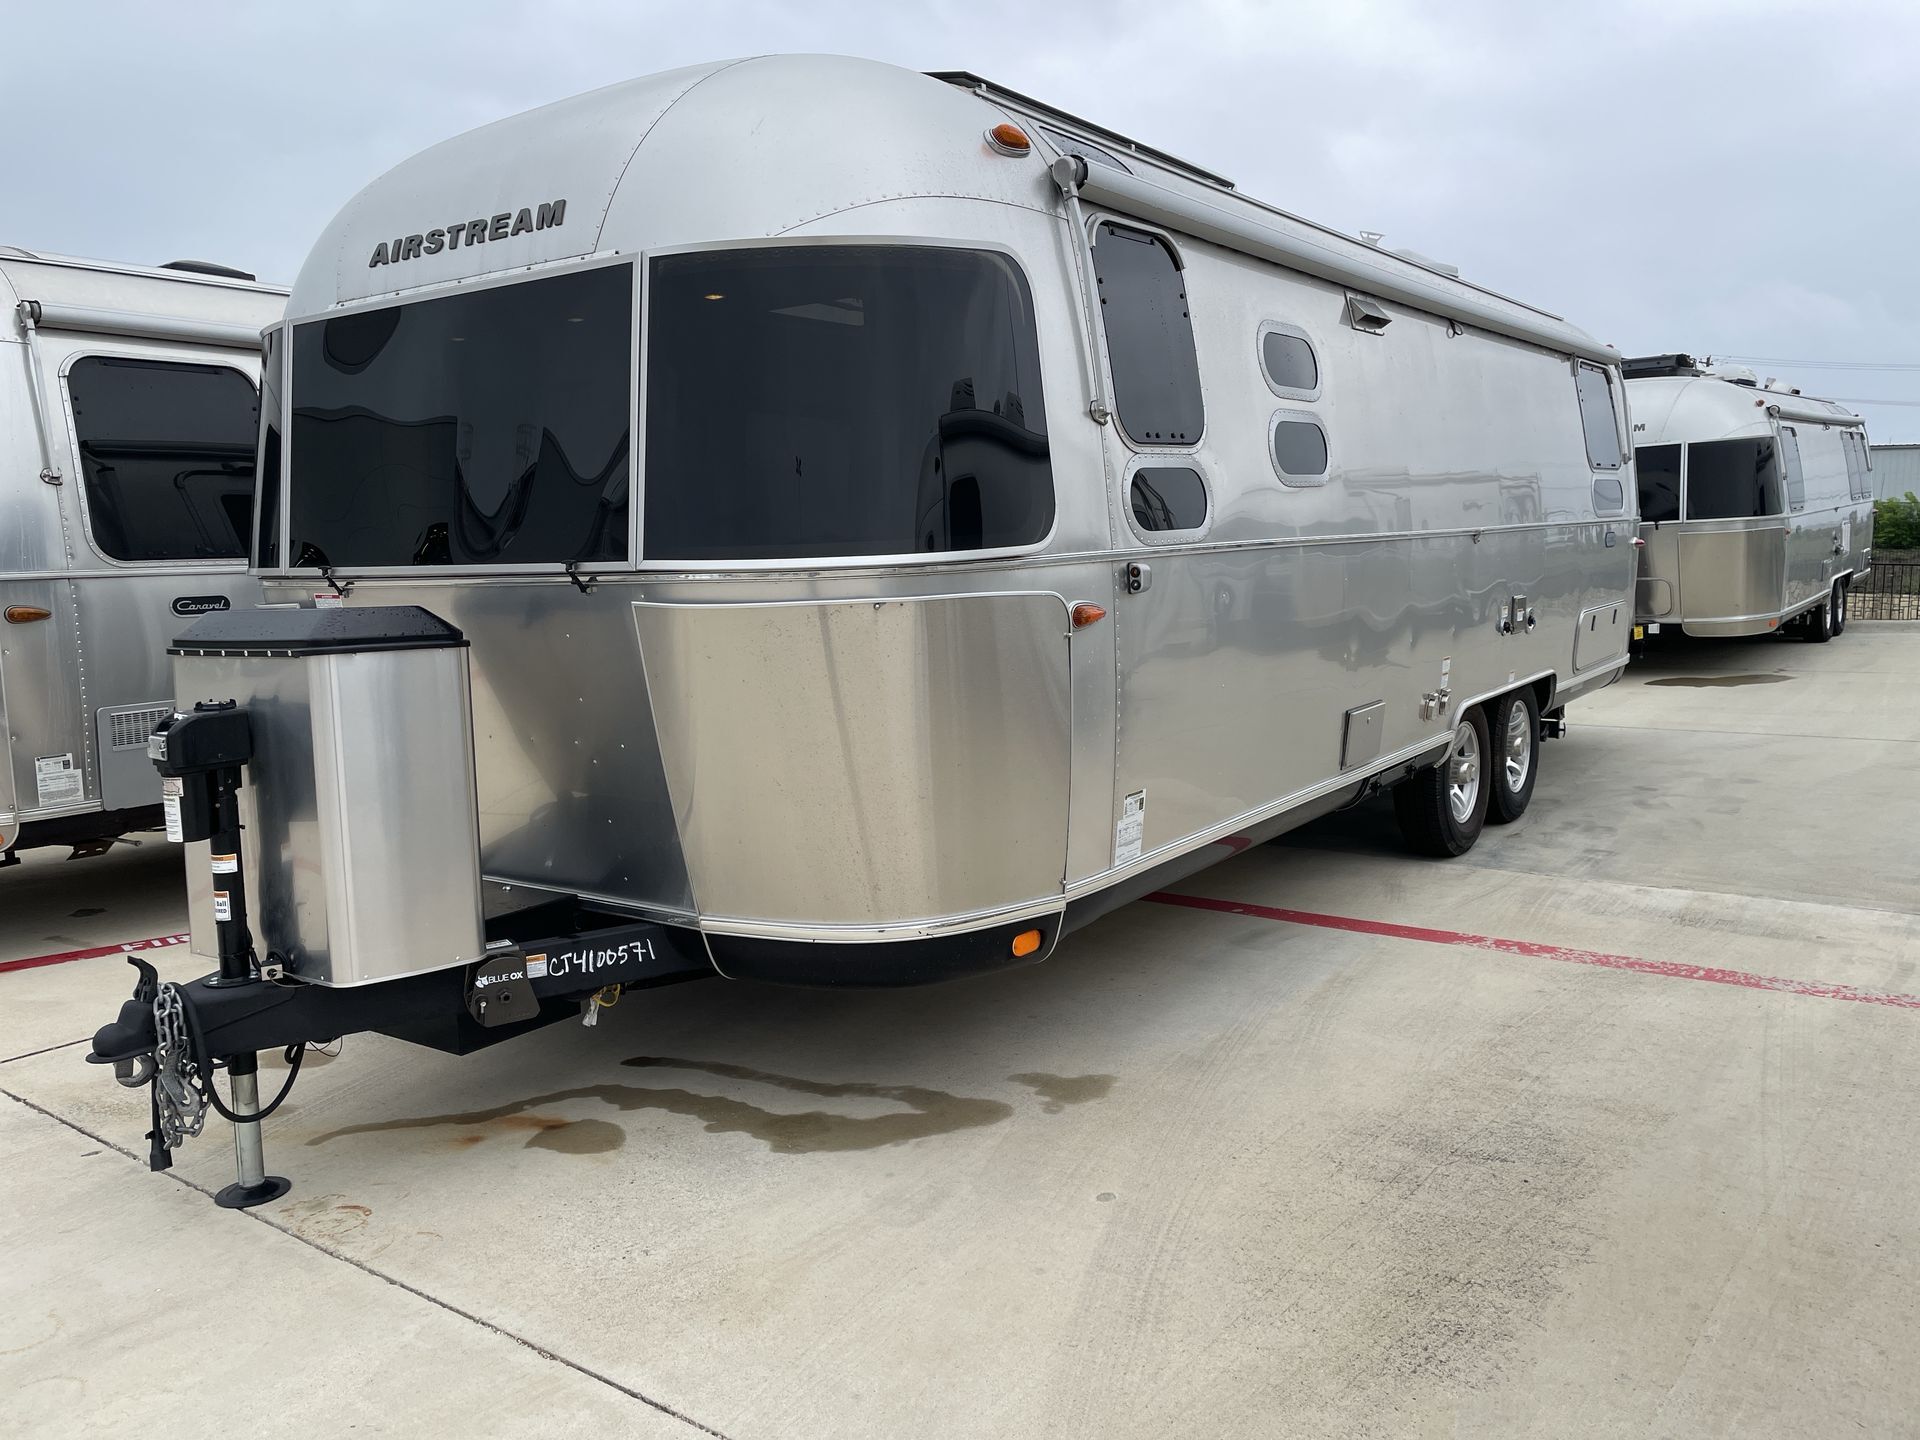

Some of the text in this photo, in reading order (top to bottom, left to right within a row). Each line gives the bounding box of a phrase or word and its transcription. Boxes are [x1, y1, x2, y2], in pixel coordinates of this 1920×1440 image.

[368, 199, 567, 268] AIRSTREAM
[176, 599, 227, 611] Caravel
[549, 938, 656, 977] CT4100571
[488, 970, 524, 984] BLUE OX
